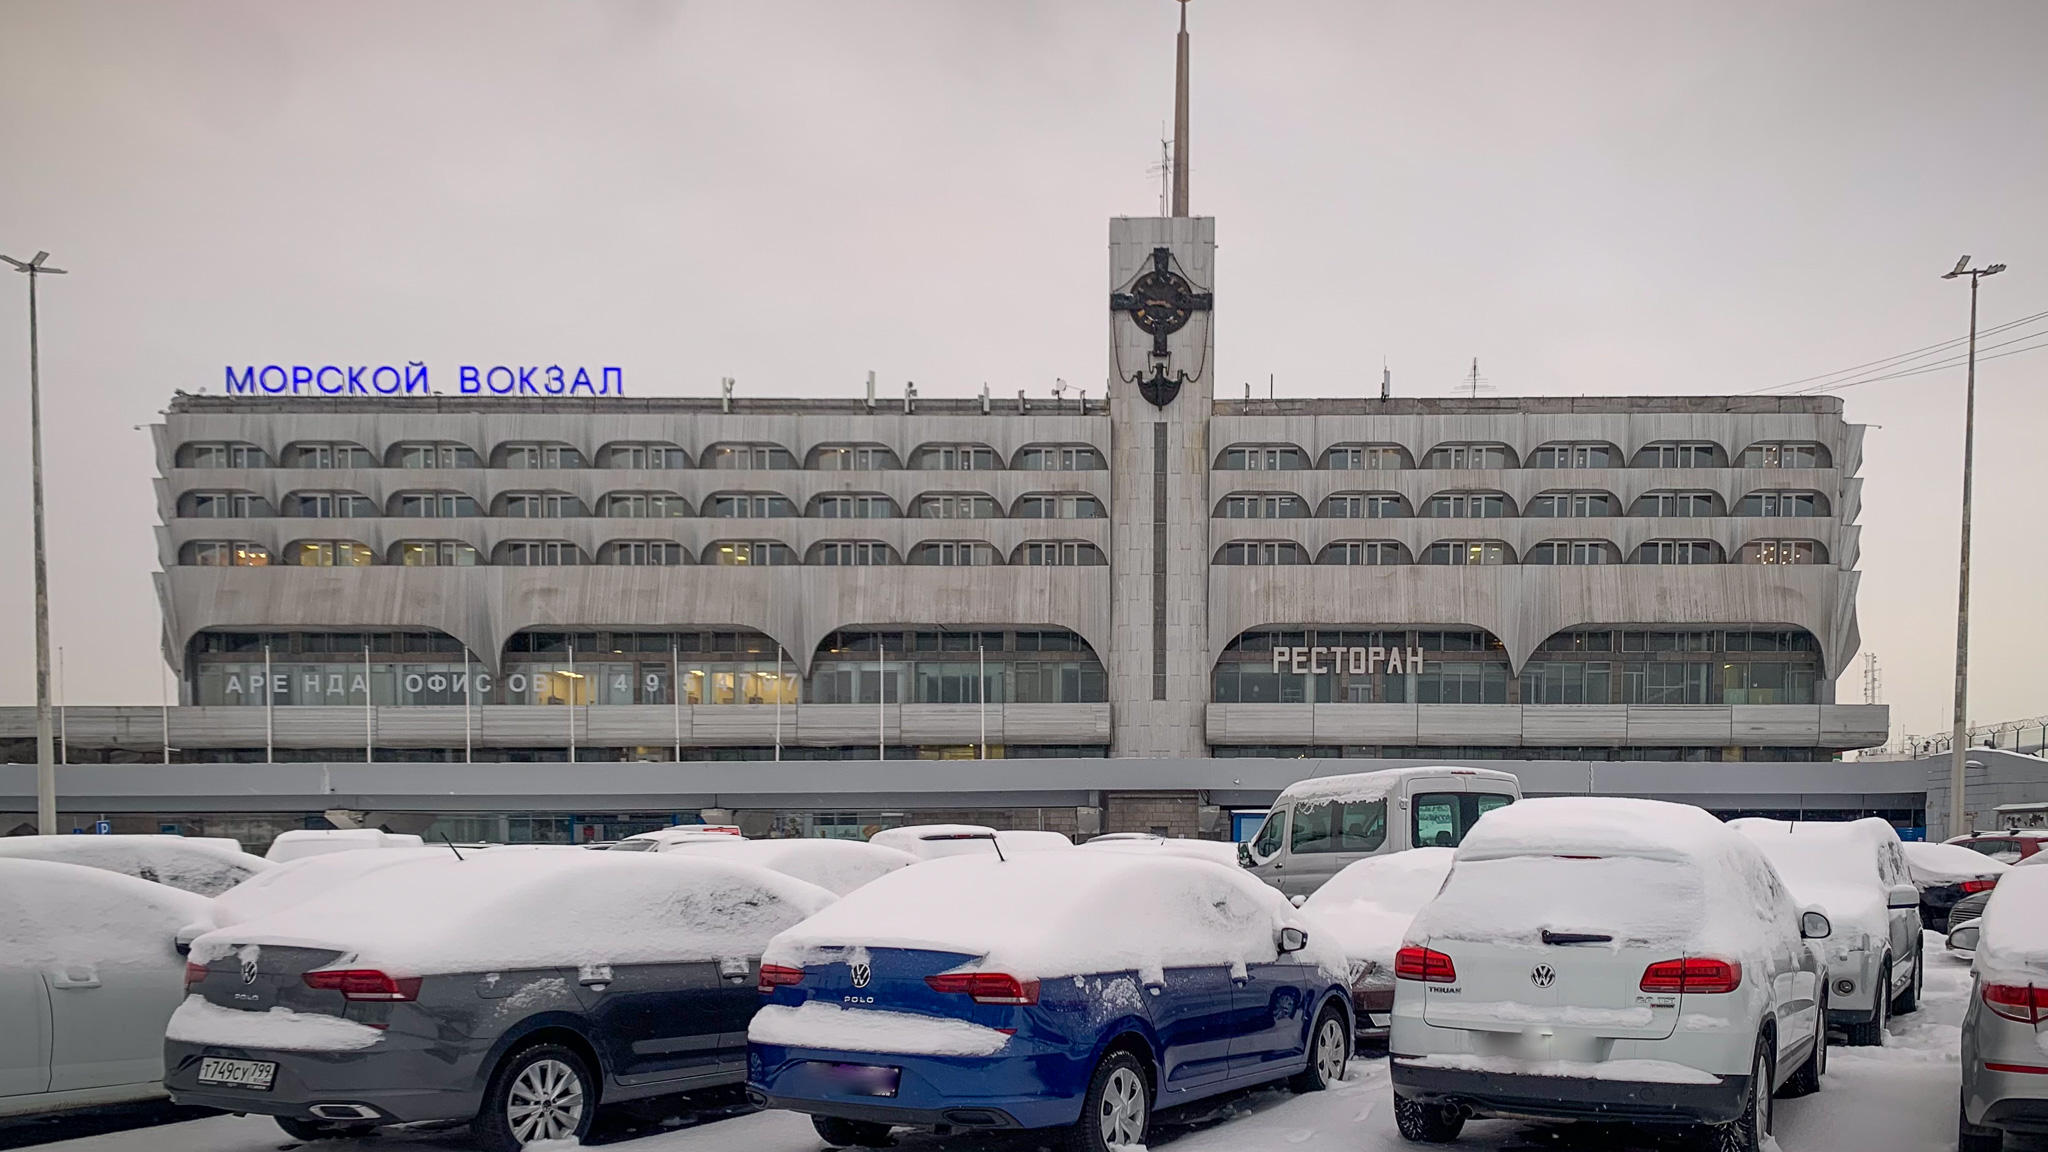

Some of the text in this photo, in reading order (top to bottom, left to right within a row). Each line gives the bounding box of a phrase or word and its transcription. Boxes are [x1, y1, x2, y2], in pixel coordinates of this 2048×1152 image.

[226, 361, 625, 395] МОРСКОЙ ВОКЗАЛ
[1272, 646, 1425, 675] РЕСТОРАН
[225, 674, 368, 696] АРЕНДА
[234, 993, 259, 1001] POLO
[844, 995, 874, 1004] POLO
[250, 1062, 273, 1079] 799
